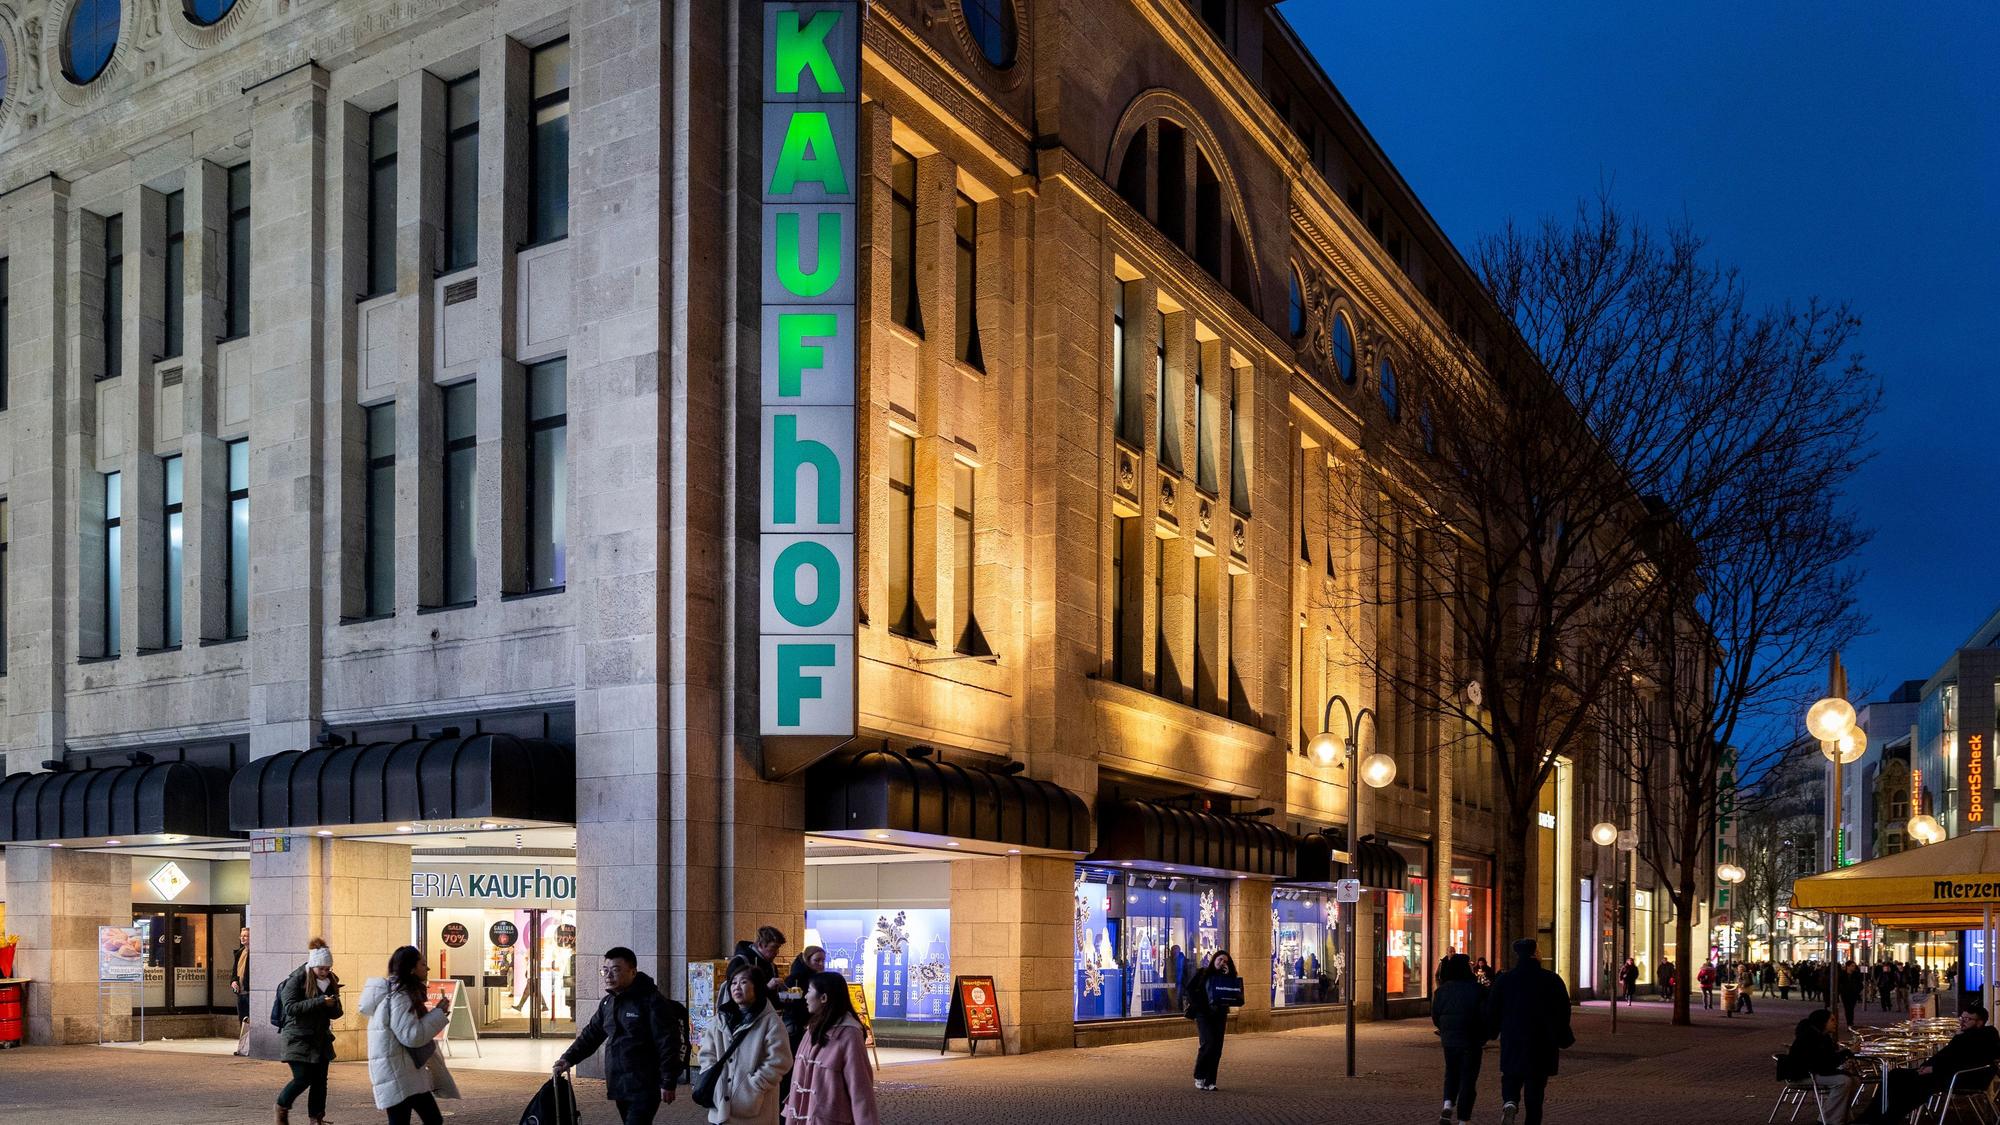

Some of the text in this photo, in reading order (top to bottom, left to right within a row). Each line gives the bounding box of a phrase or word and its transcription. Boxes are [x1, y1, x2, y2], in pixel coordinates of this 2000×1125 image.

[768, 11, 849, 726] KAUFhOF
[1968, 734, 1984, 822] SportScheck
[444, 934, 468, 943] 70%
[176, 973, 206, 981] Fritten
